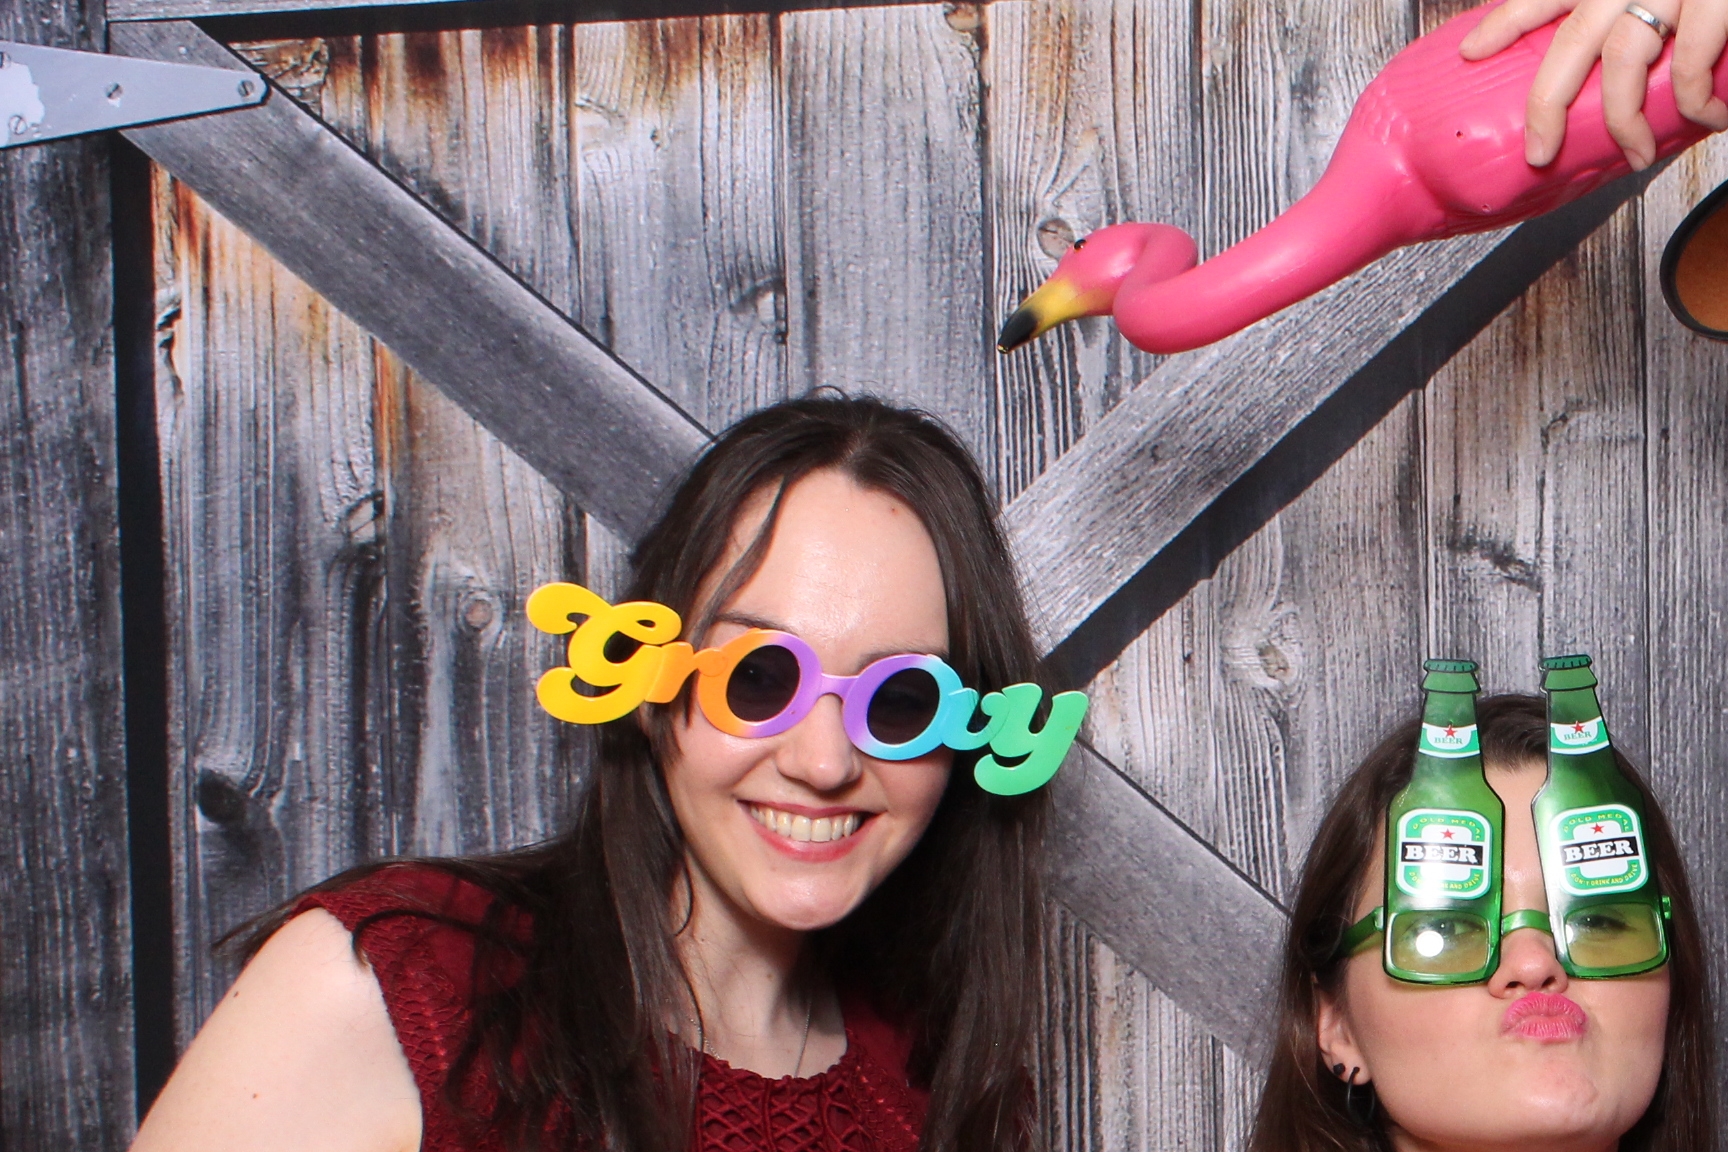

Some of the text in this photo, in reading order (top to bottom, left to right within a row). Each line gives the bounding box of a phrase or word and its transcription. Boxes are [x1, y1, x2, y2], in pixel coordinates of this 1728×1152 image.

[1434, 736, 1463, 745] BEER
[1563, 730, 1592, 740] BEER
[1412, 817, 1481, 840] GOLD MEDAL
[1563, 813, 1629, 833] GOLD MEDAL
[1404, 844, 1478, 864] BEER
[1563, 839, 1634, 863] BEER
